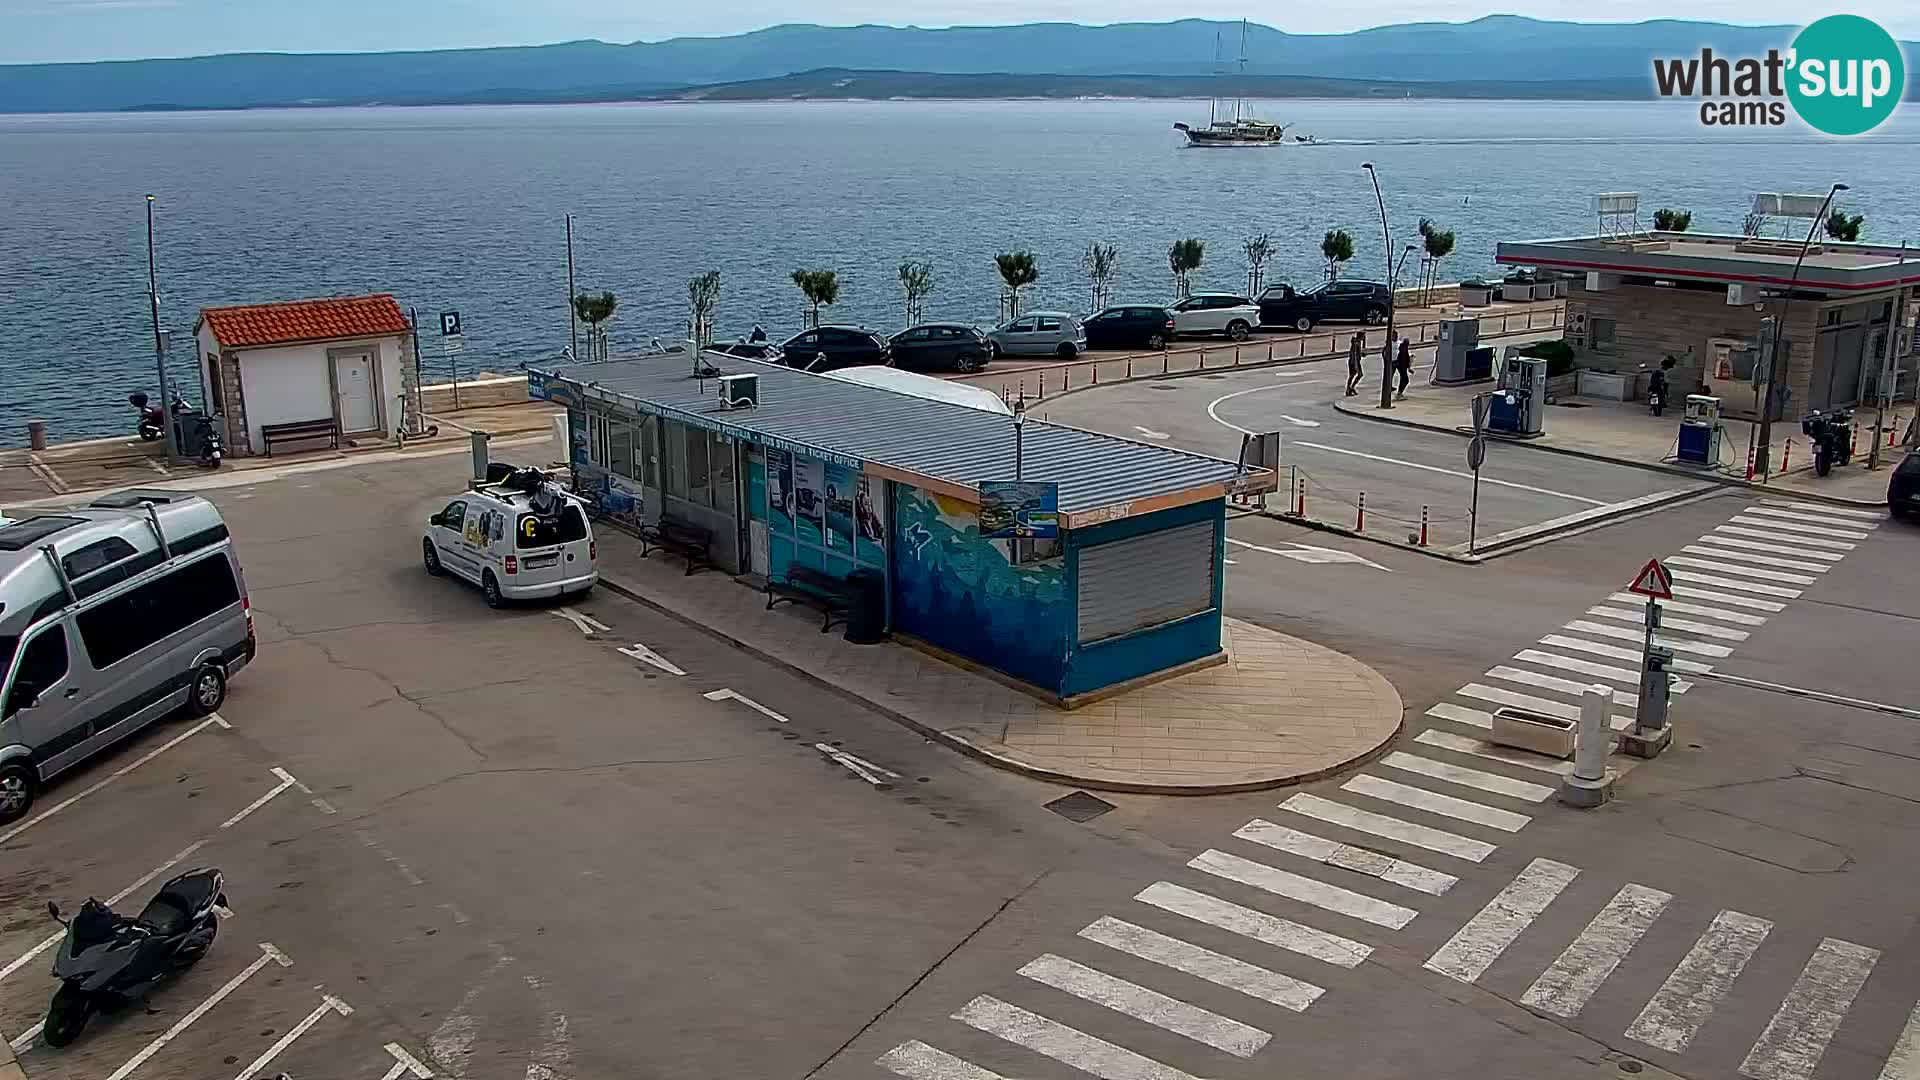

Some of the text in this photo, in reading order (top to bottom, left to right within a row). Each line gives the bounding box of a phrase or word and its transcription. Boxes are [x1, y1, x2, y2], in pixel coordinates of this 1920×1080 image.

[445, 315, 456, 333] P
[760, 434, 775, 447] BUS
[775, 439, 806, 455] STATION
[808, 447, 833, 462] TICKET
[834, 454, 860, 469] OFFICE
